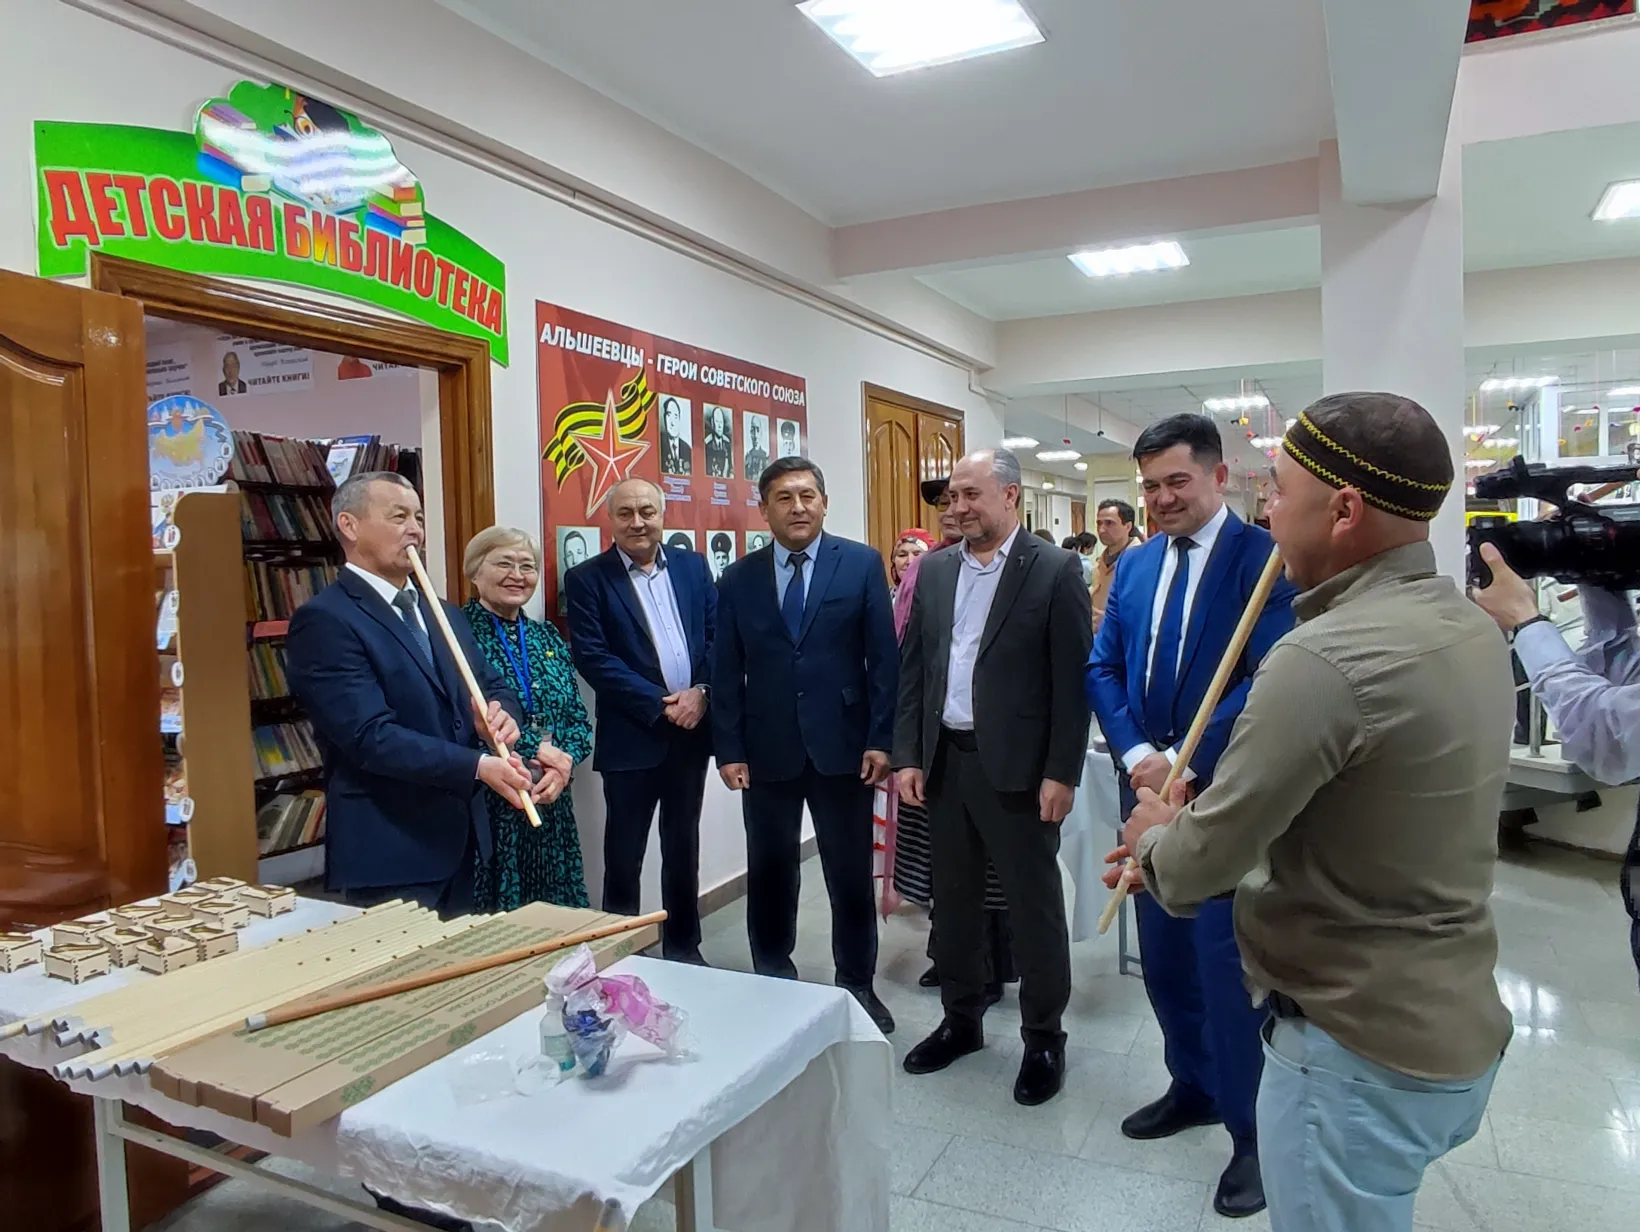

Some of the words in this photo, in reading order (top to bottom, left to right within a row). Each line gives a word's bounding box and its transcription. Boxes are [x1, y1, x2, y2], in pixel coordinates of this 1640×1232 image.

[44, 170, 275, 252] ДЕТСКАЯ
[284, 202, 503, 335] БИБЛИОТЕКА
[540, 323, 645, 368] АЛЬШЕЕВЦЫ
[656, 353, 698, 381] ГЕРОИ
[700, 365, 770, 398] СОВЕТСКОГО
[772, 384, 805, 407] СОЮЗА
